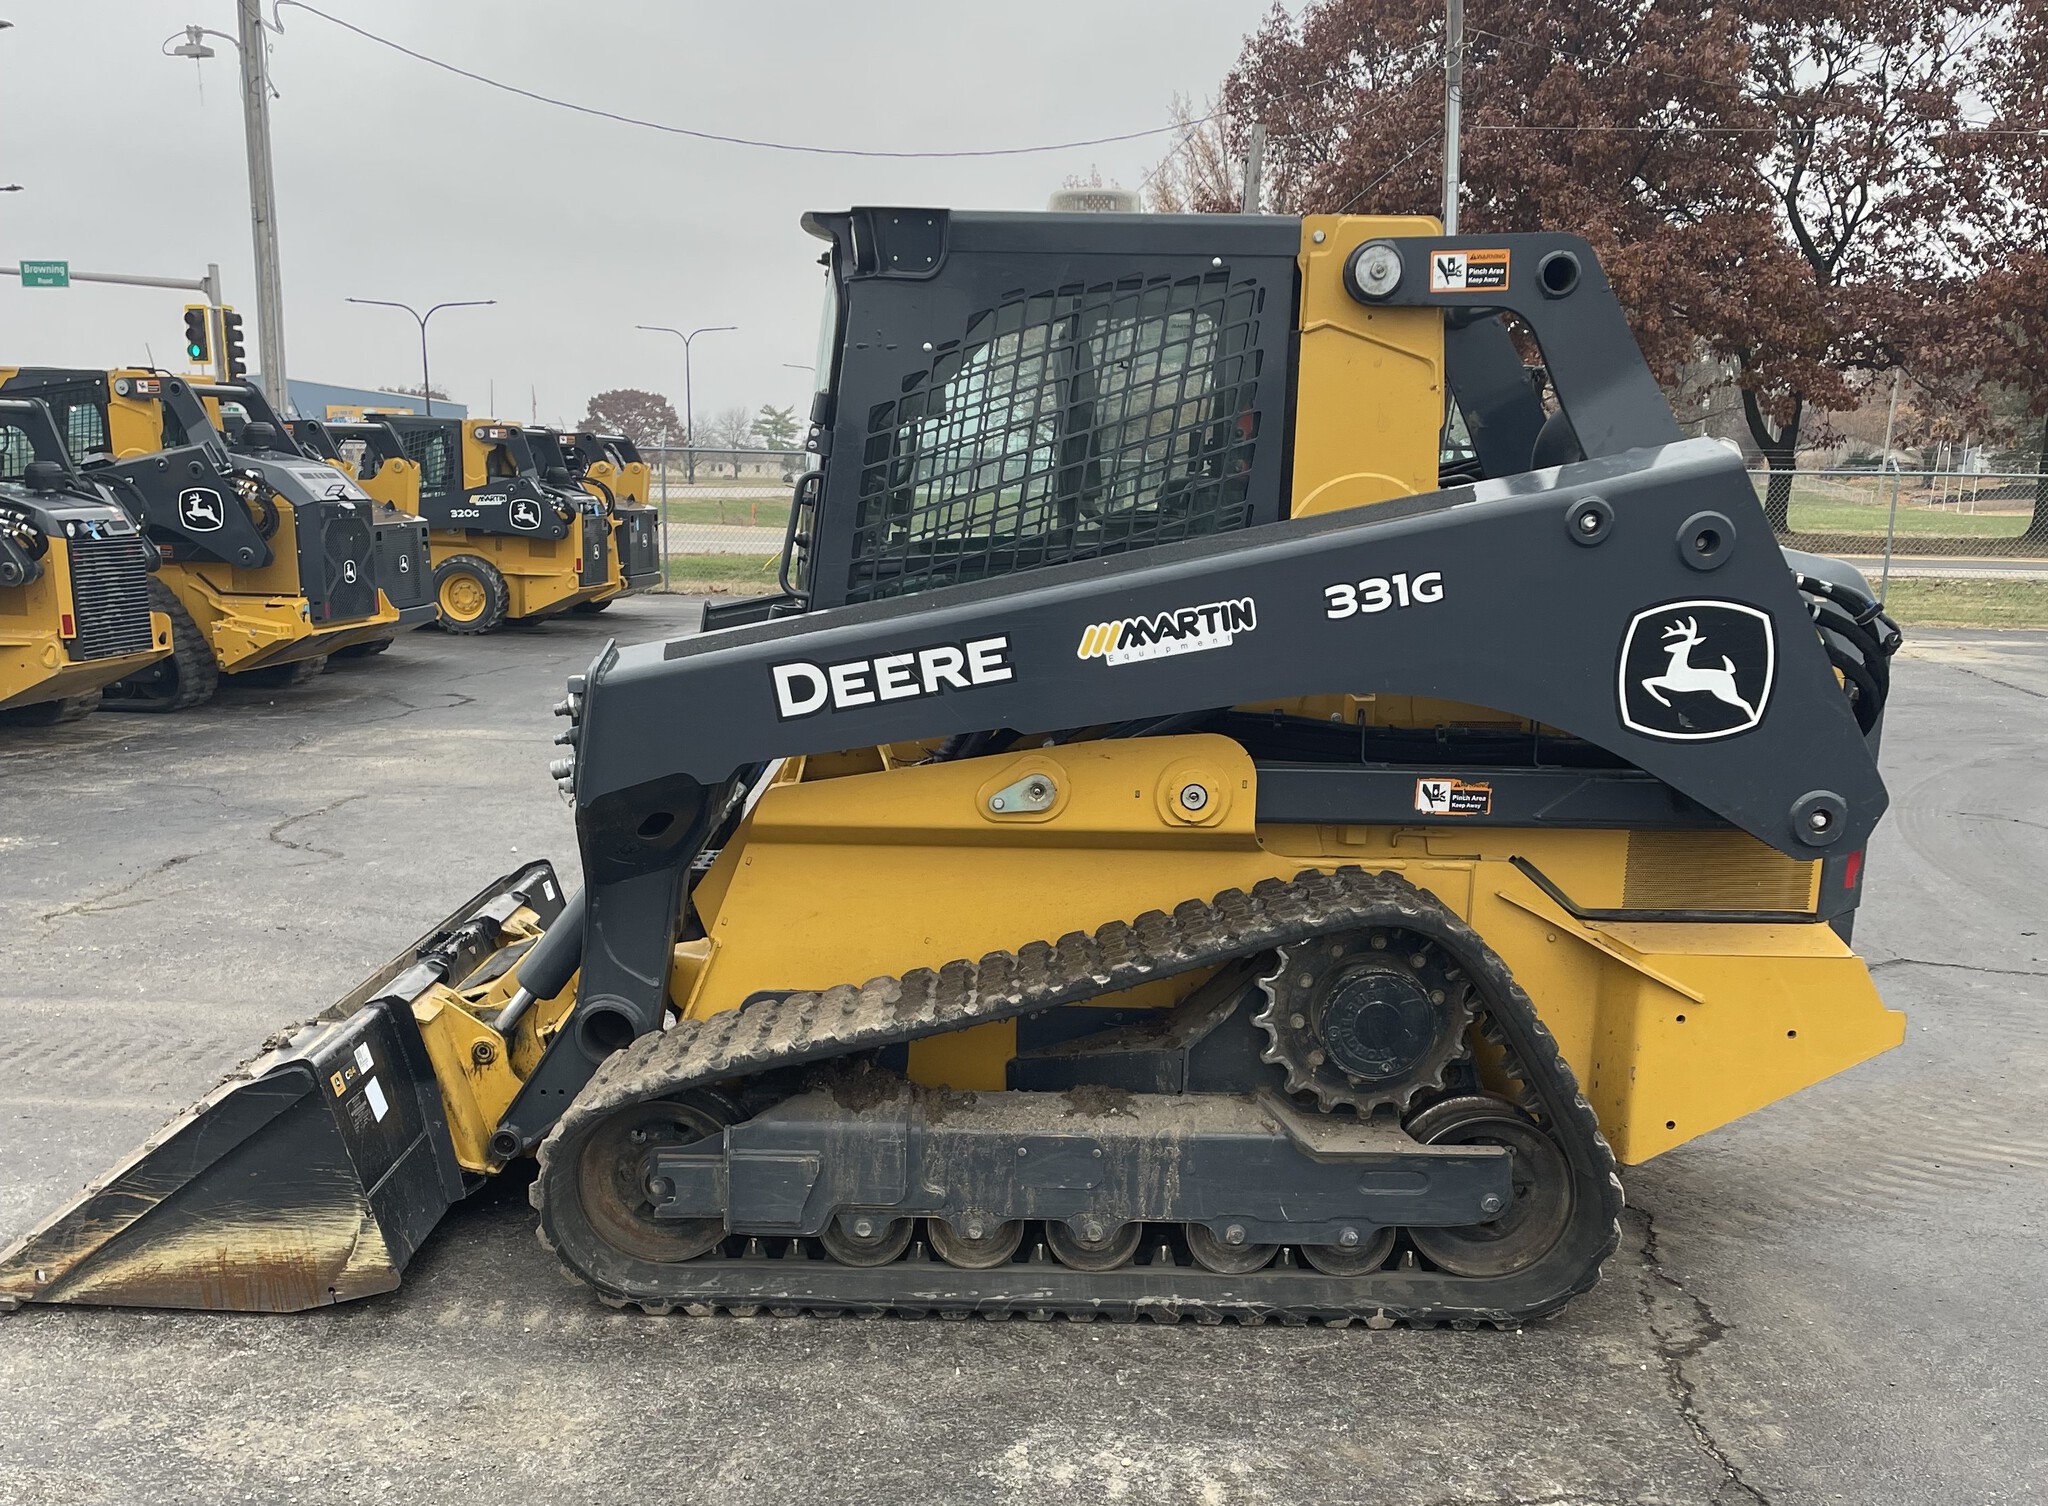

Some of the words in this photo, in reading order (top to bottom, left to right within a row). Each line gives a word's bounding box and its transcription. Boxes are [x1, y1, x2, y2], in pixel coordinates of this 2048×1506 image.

[23, 263, 65, 276] Browning
[1468, 267, 1488, 275] Pinch
[1488, 267, 1505, 275] Area
[1483, 276, 1500, 284] Away
[478, 494, 507, 503] MARTIN
[450, 508, 480, 519] 320G
[1324, 571, 1444, 619] 331G
[1116, 599, 1255, 651] MARTIN
[1107, 634, 1231, 663] Equipment
[772, 636, 1013, 718] DEERE
[1471, 794, 1487, 802] Area
[1466, 802, 1482, 810] Away
